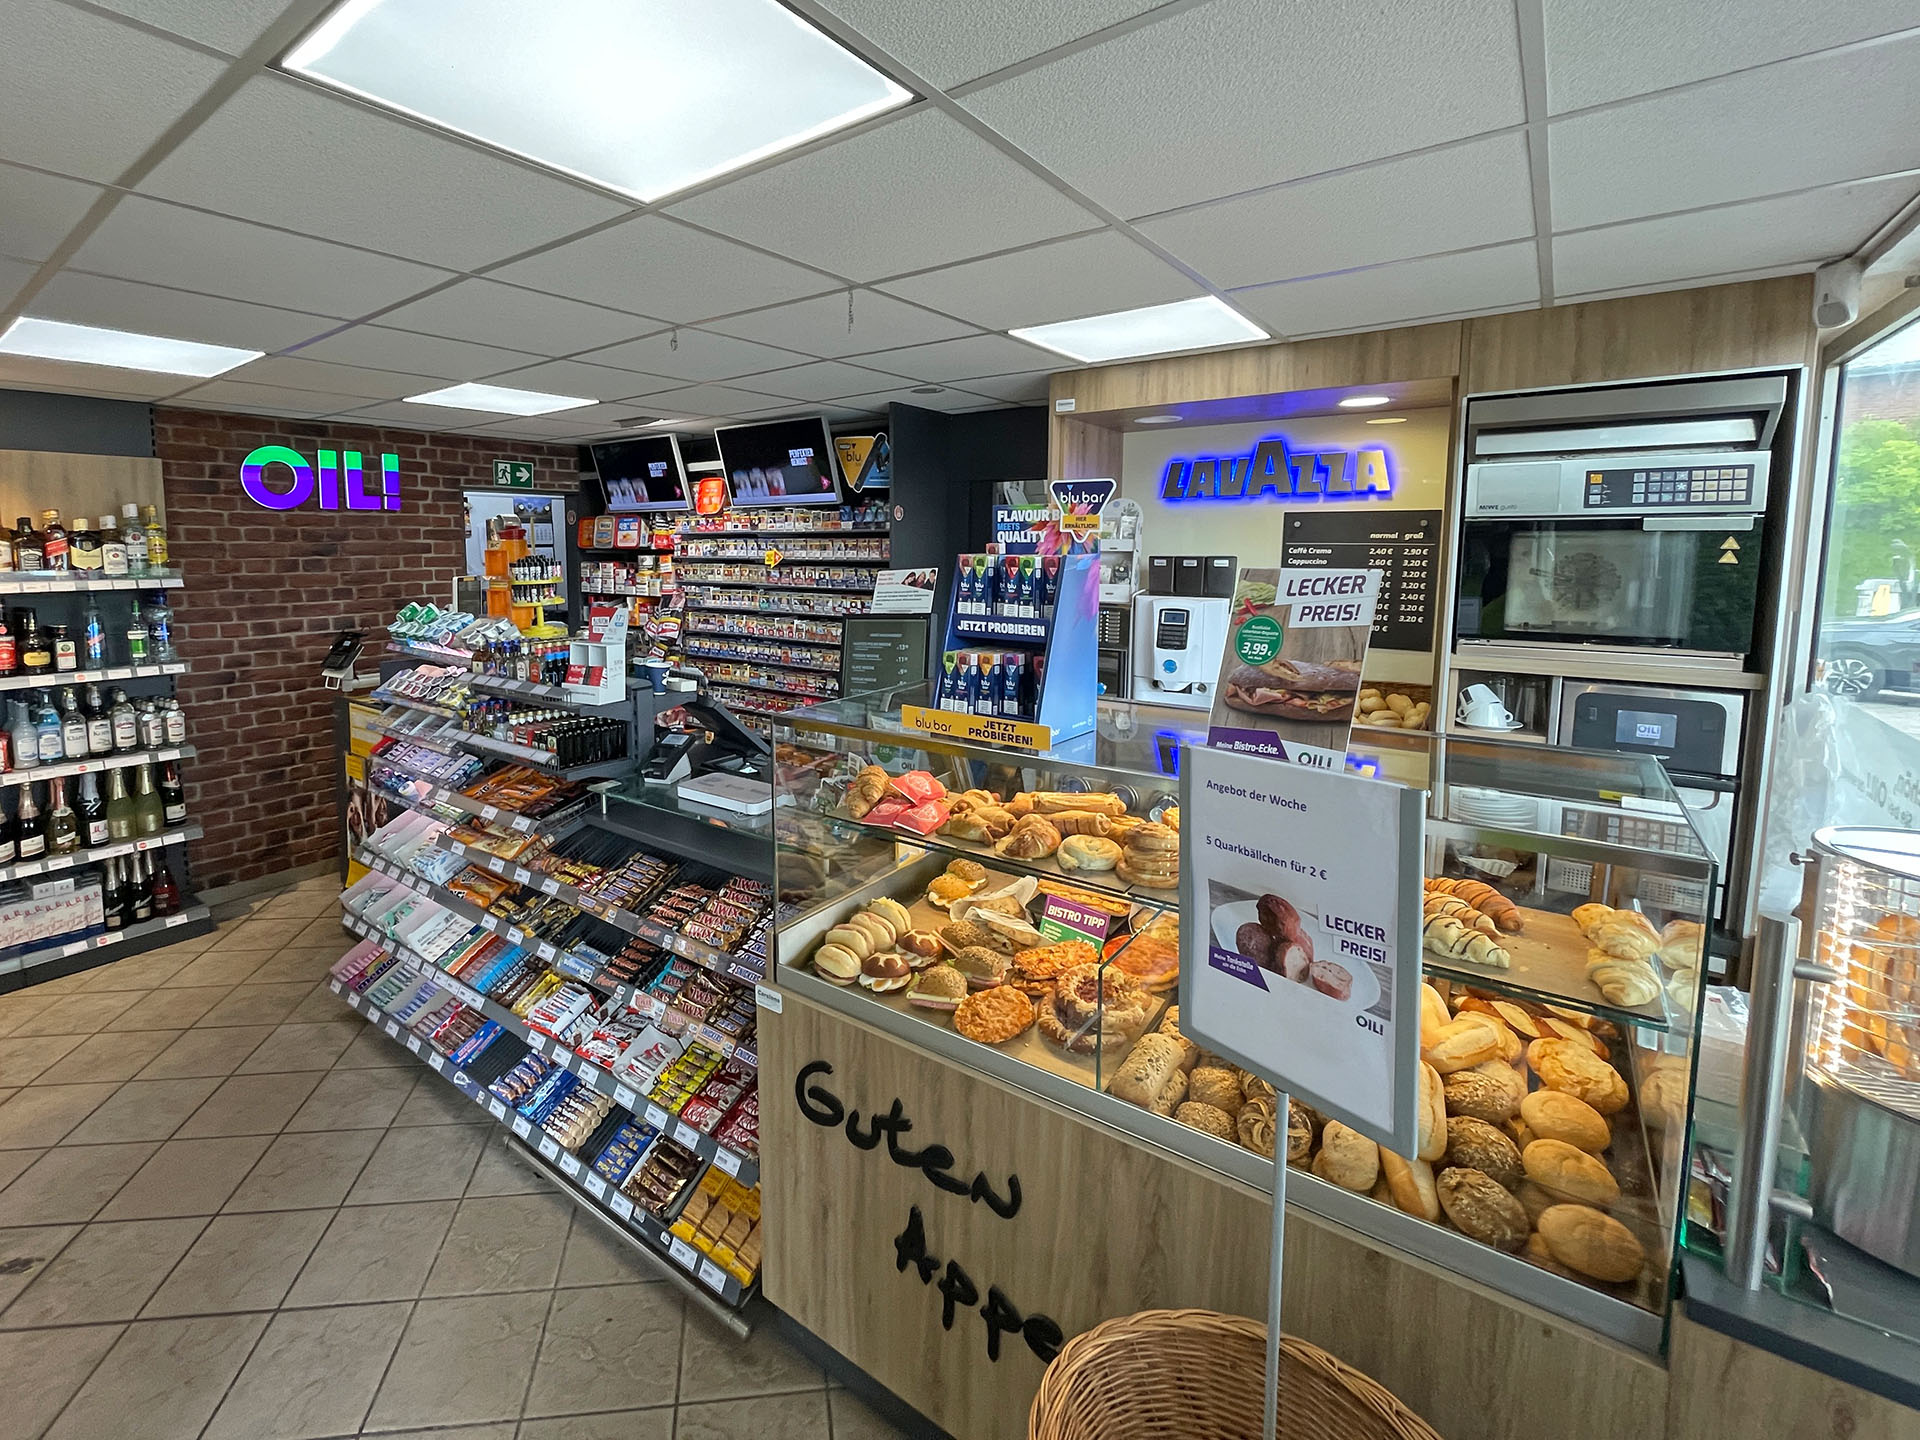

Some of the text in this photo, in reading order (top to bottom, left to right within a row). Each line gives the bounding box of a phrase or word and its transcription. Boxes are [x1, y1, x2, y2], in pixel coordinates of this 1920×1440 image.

[240, 445, 401, 510] OIL!
[1162, 440, 1391, 498] LAVAZZA
[997, 509, 1050, 522] FLAVOUR
[997, 522, 1020, 530] MEETS
[997, 531, 1047, 543] QUALITY
[1286, 575, 1367, 597] LECKER
[1299, 603, 1362, 622] PREIS!
[958, 620, 1045, 636] JETZT PROBIEREN
[1241, 642, 1268, 655] 3,99
[932, 719, 952, 732] bar
[984, 720, 1016, 733] JETZT
[968, 728, 1033, 746] PROBIEREN!
[1234, 740, 1279, 755] Bistro-Ecke.
[1206, 780, 1307, 812] Angebot der Woche
[1206, 836, 1328, 880] 5 Quarkbällchen für 2 €
[714, 899, 738, 919] TWIX
[1048, 904, 1105, 928] BISTRO TIPP
[1326, 914, 1386, 942] LECKER
[1340, 940, 1386, 964] PREIS!
[727, 962, 736, 974] 2
[681, 1001, 706, 1018] TWIX
[1356, 1015, 1384, 1036] OIL!
